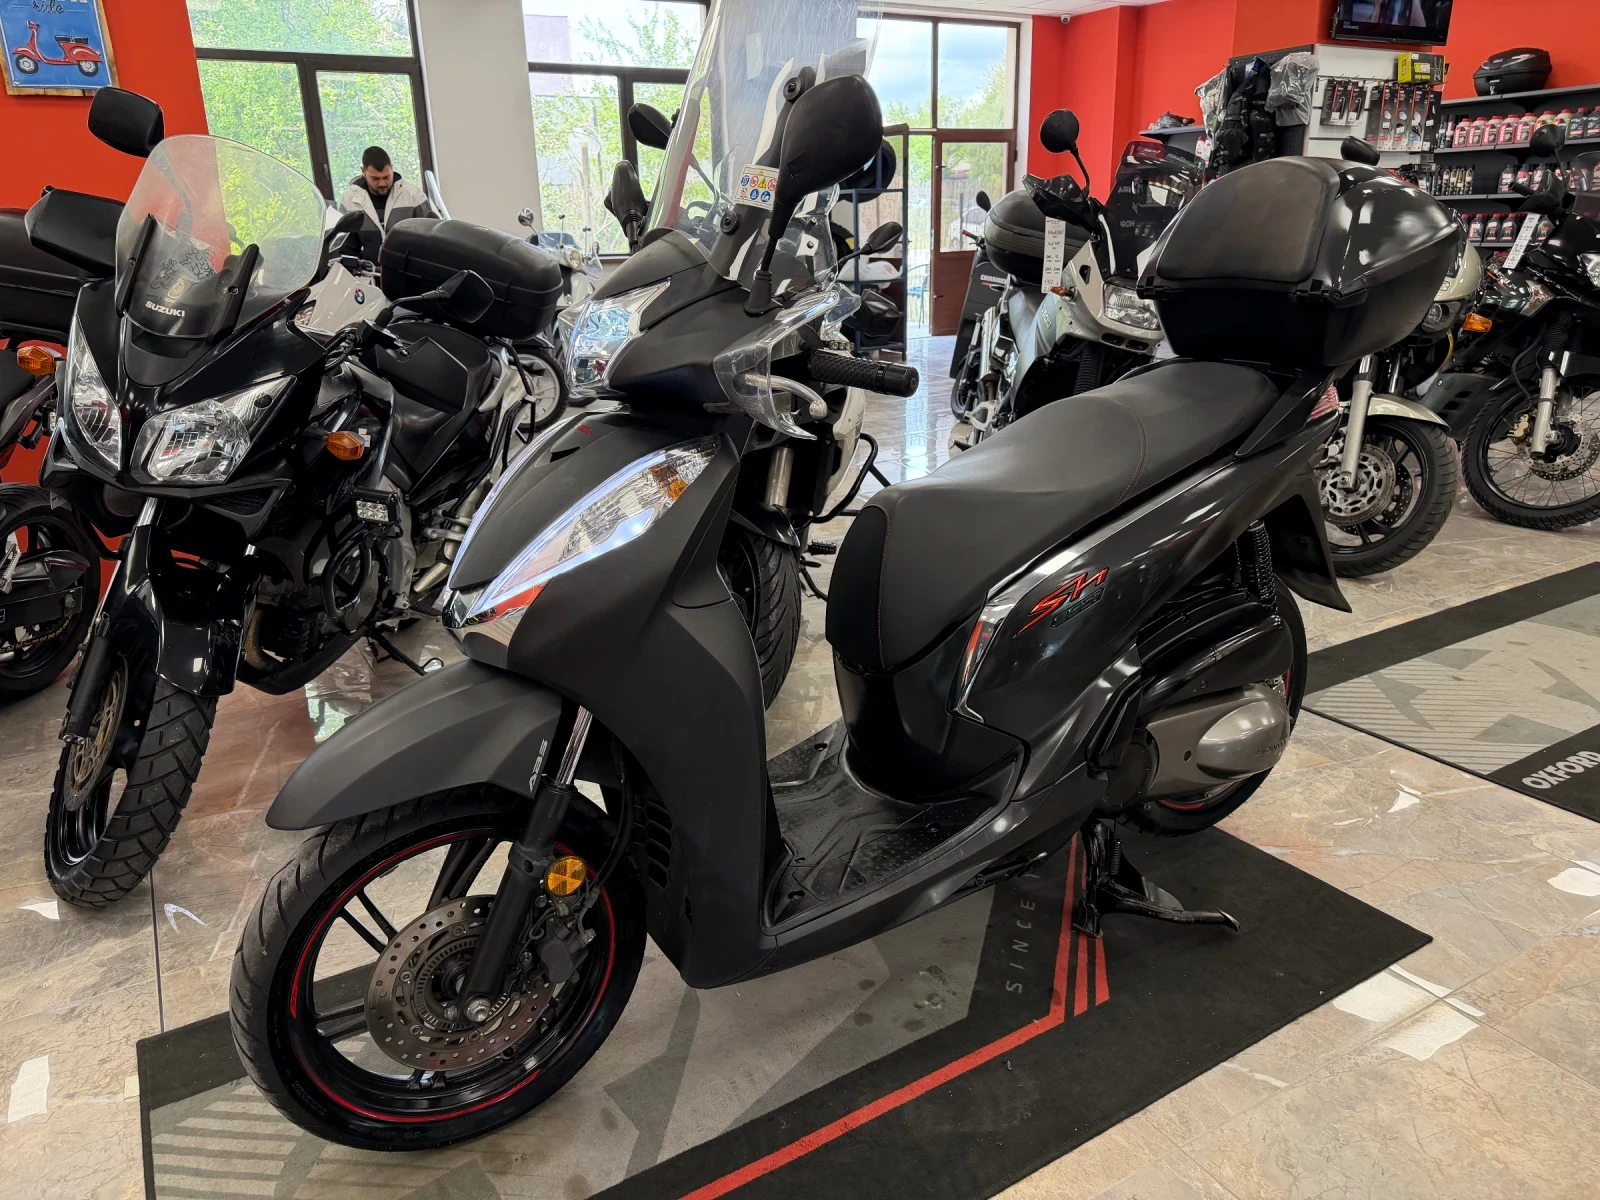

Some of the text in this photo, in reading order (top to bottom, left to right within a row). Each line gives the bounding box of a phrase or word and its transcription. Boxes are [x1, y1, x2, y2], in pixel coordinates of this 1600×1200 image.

[145, 300, 186, 317] SUZUKI
[1013, 567, 1110, 638] SH
[528, 738, 548, 793] ABS
[1521, 751, 1600, 789] OXFORD
[1005, 899, 1036, 993] SINCE
